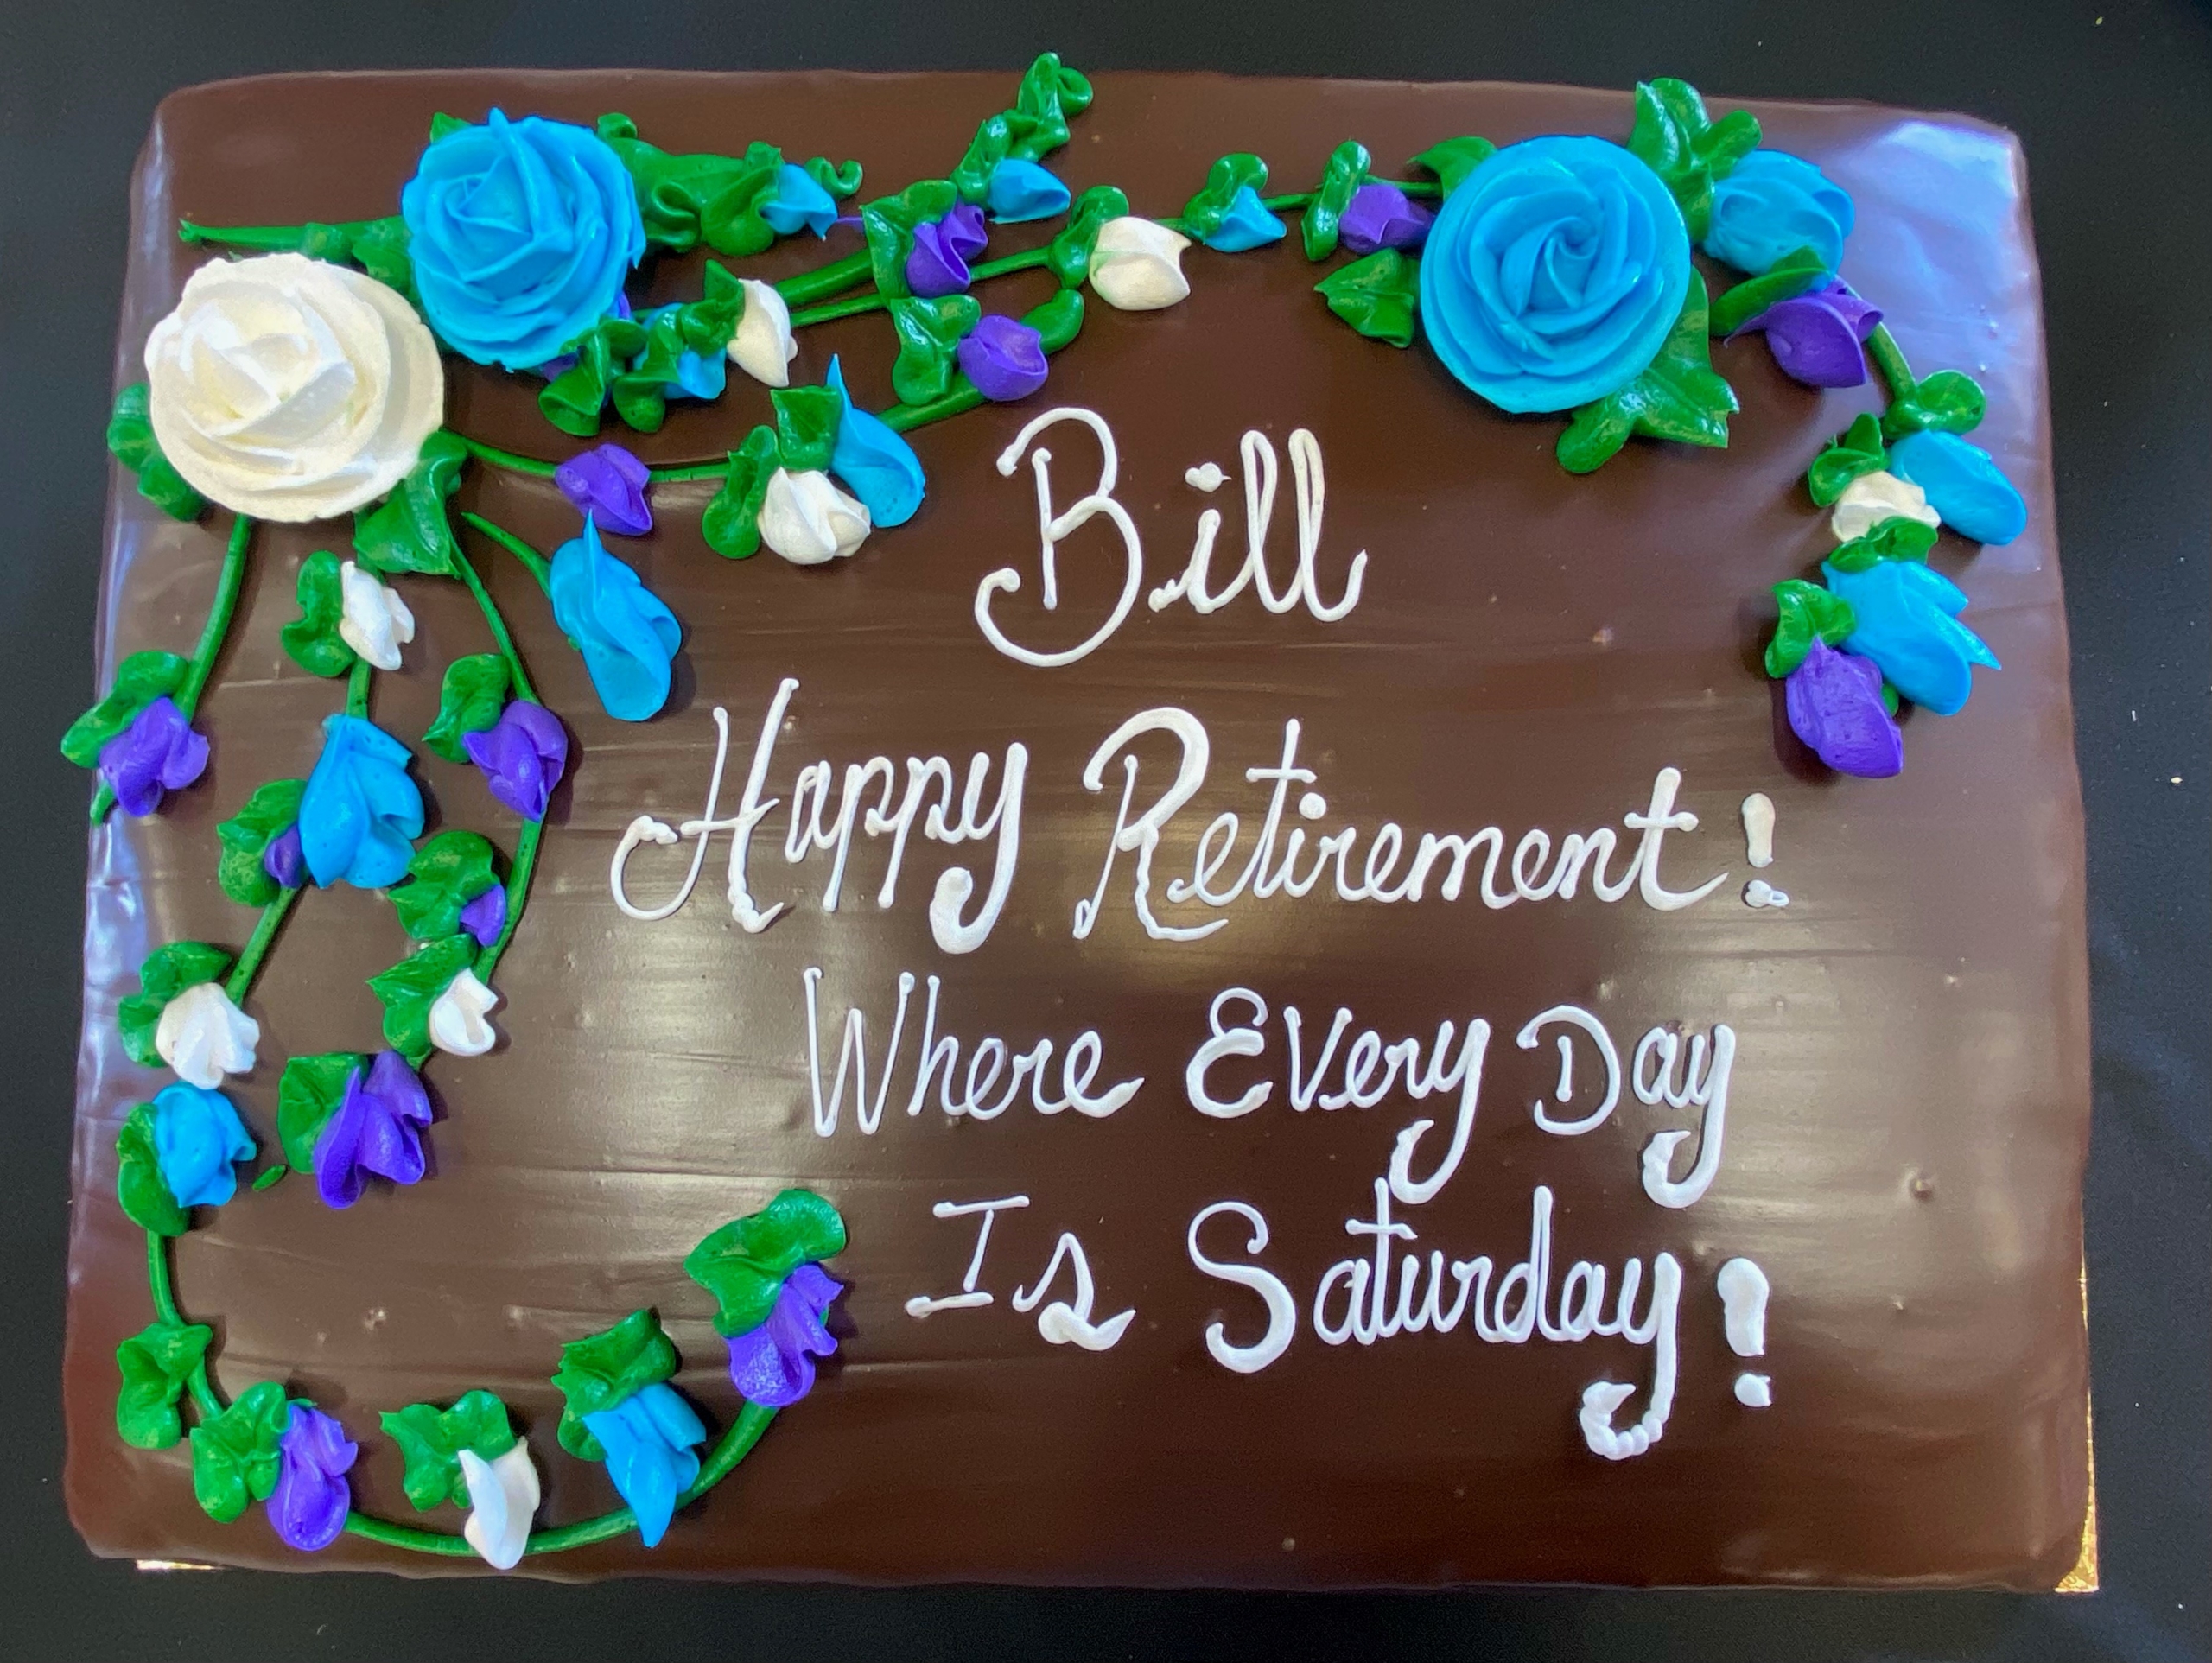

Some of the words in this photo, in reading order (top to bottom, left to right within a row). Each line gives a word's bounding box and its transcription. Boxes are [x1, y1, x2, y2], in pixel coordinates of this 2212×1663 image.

[973, 406, 1369, 668] Bill
[609, 677, 1029, 955] Happy
[802, 966, 1145, 1139] Where
[1185, 987, 1490, 1203] Every
[1515, 1004, 1737, 1209] Day
[903, 1194, 1137, 1353] Is
